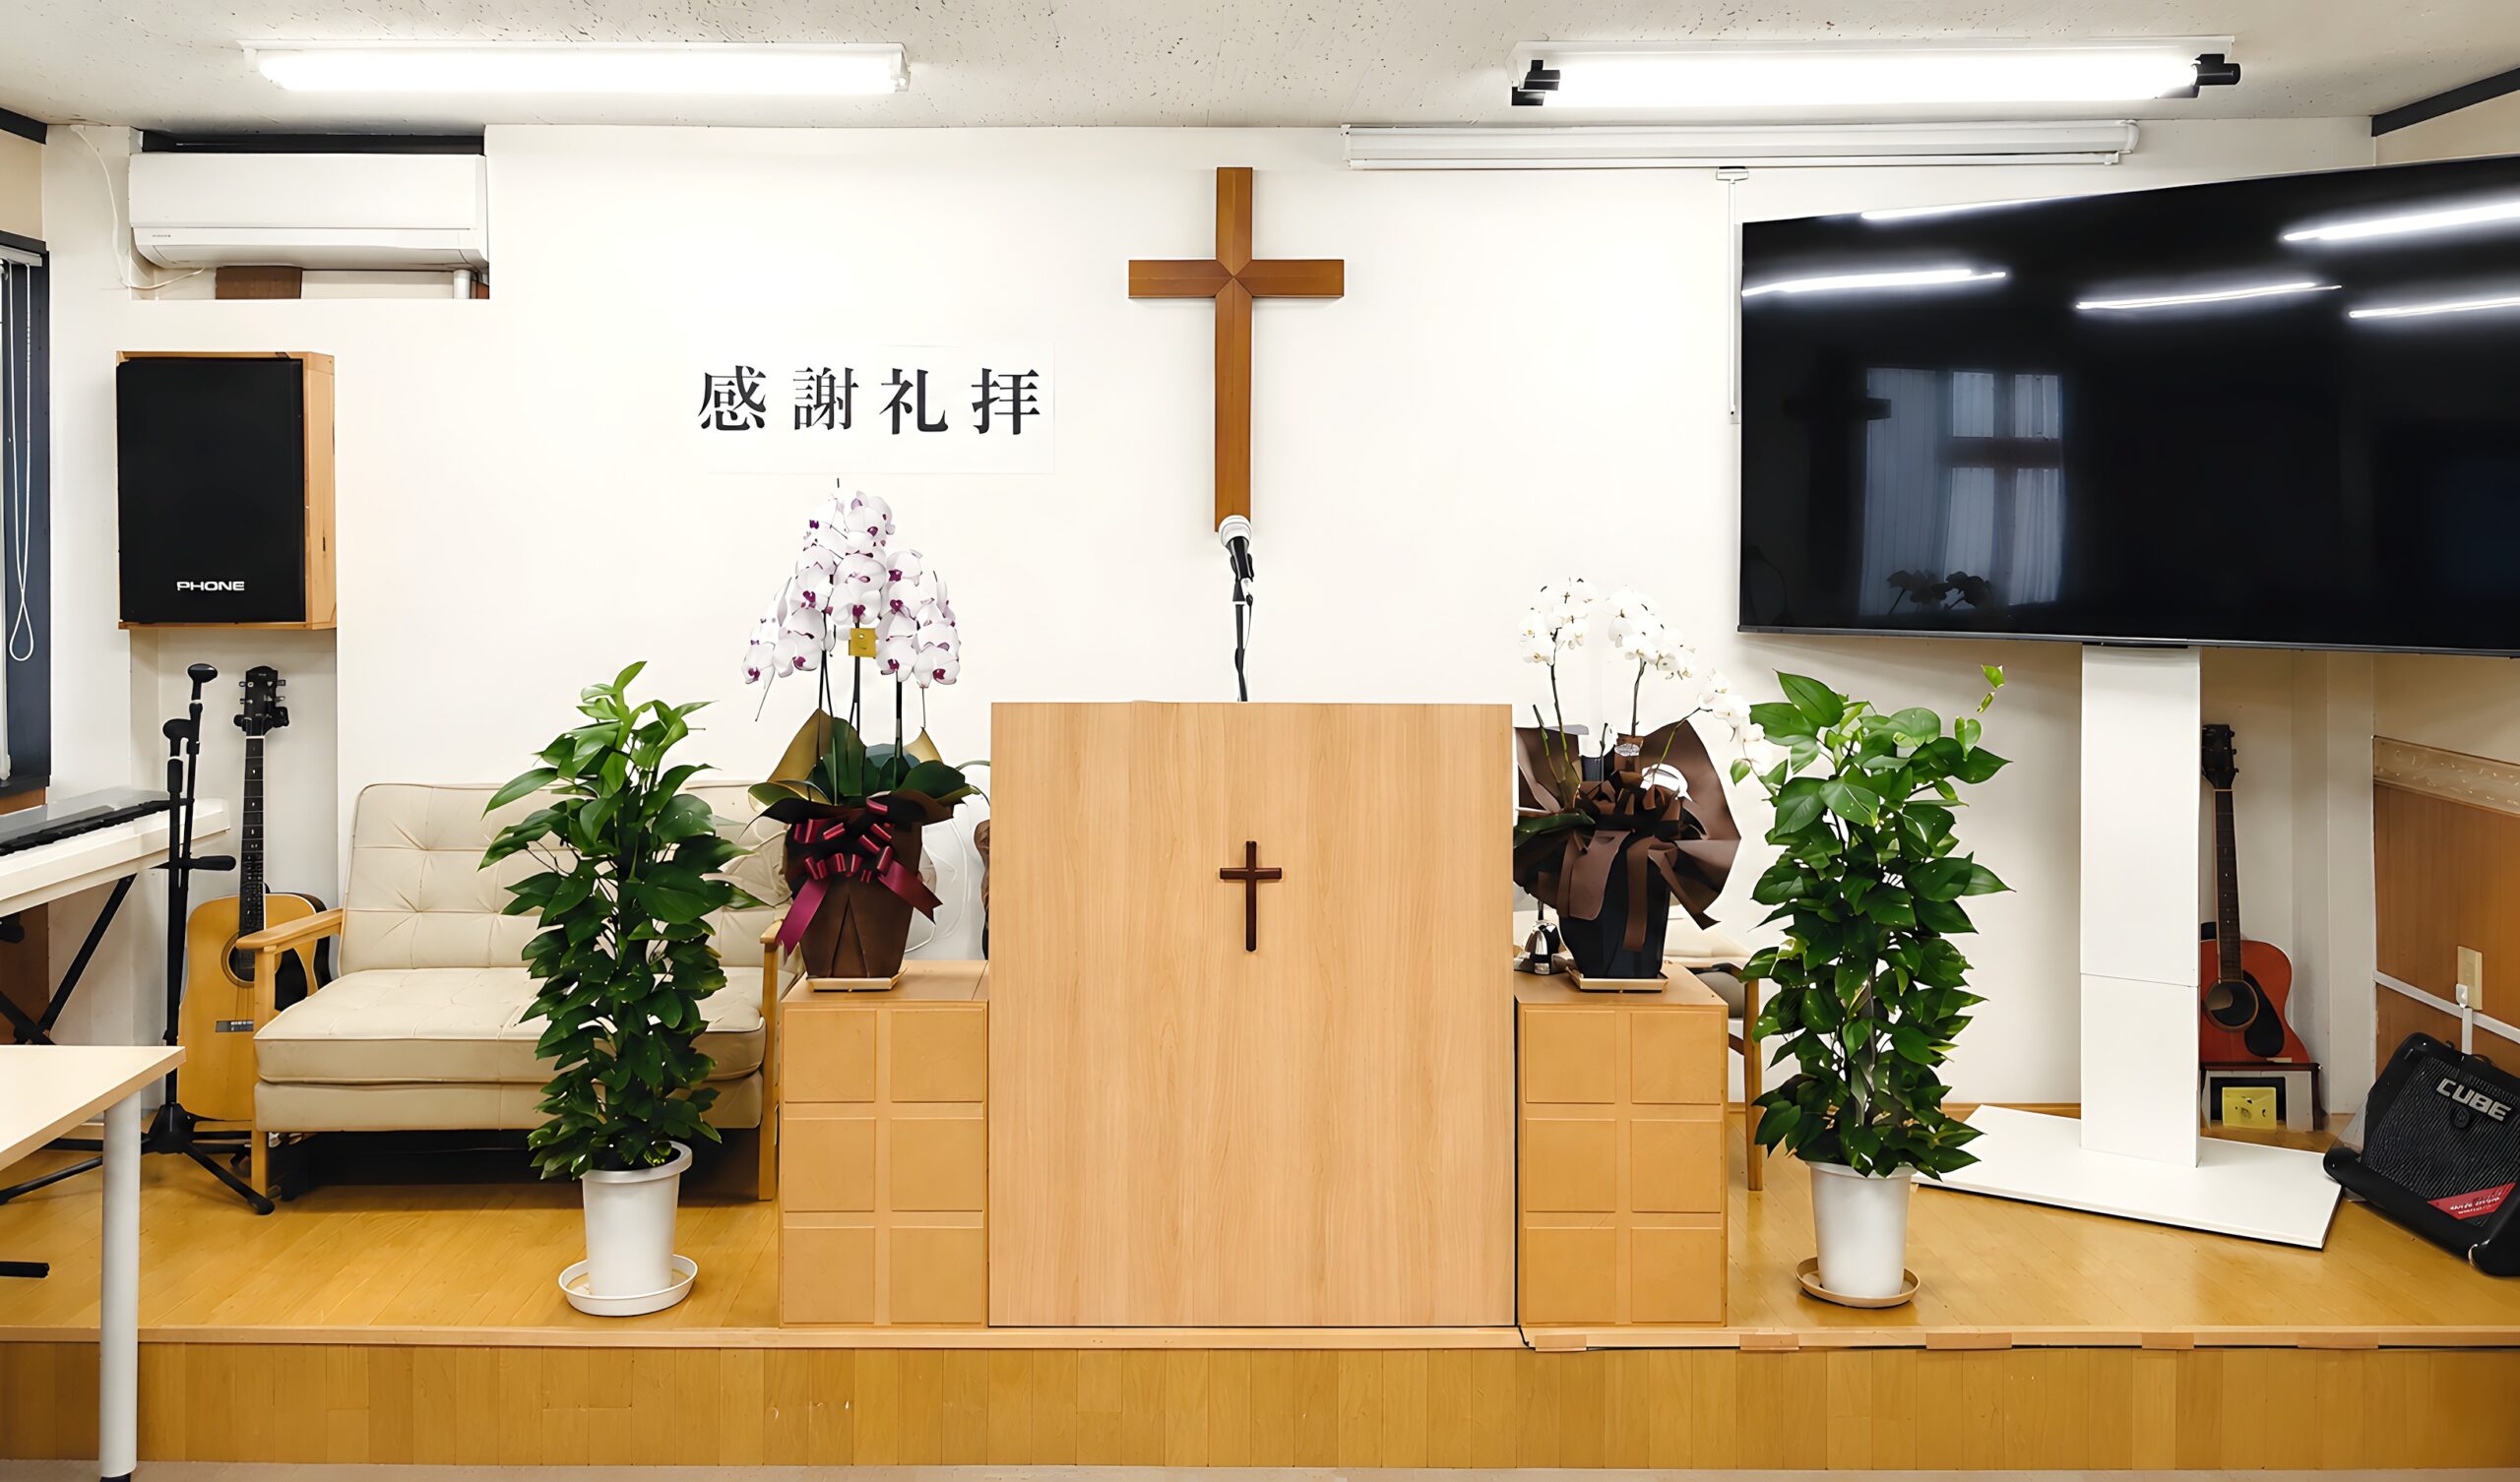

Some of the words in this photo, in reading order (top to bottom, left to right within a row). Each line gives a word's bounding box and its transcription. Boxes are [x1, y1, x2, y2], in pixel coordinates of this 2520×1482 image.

[698, 365, 1040, 435] 感謝礼拝
[176, 581, 245, 591] PHONE
[2436, 1078, 2512, 1122] CUBE
